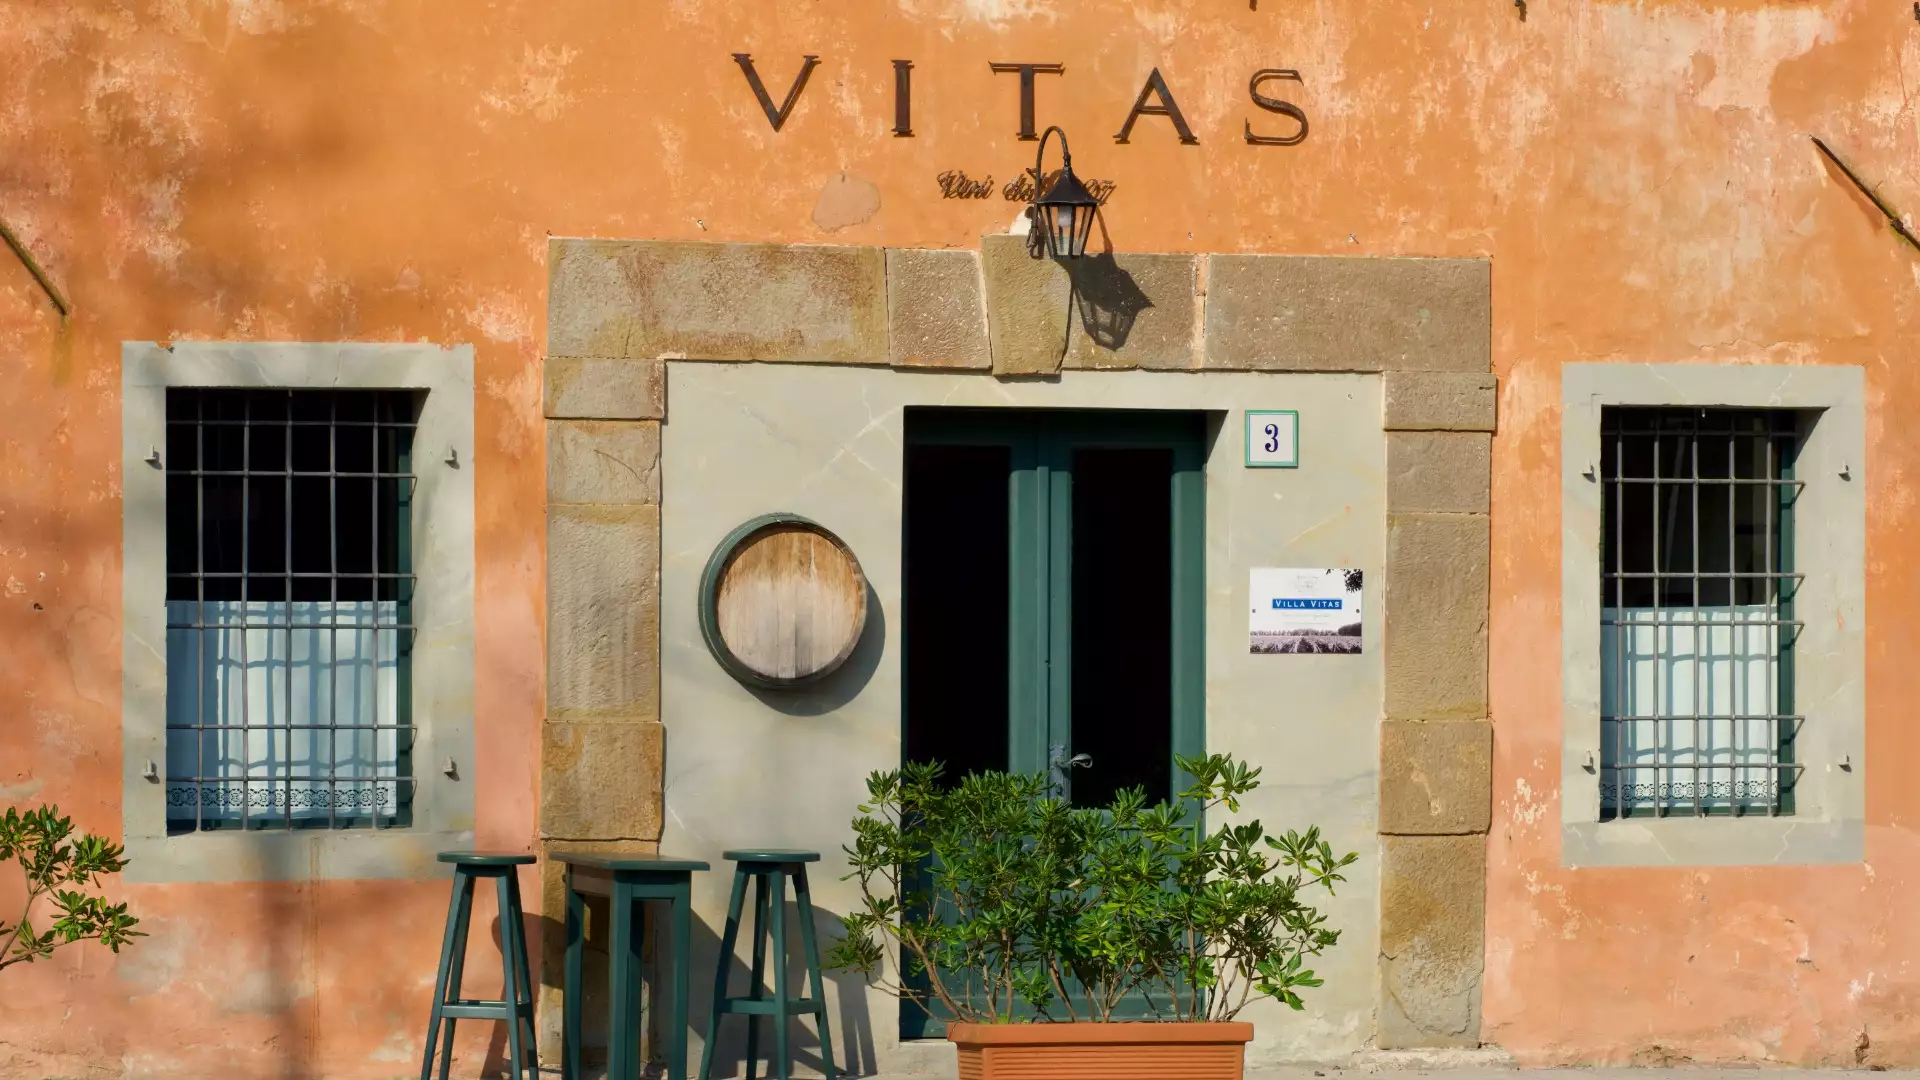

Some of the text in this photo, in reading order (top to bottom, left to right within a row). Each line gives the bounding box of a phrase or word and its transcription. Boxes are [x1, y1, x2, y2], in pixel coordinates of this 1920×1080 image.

[731, 52, 1310, 147] VITAS
[937, 169, 995, 200] Vini
[1264, 423, 1279, 453] 3
[1275, 599, 1340, 608] VILLA VITAS
